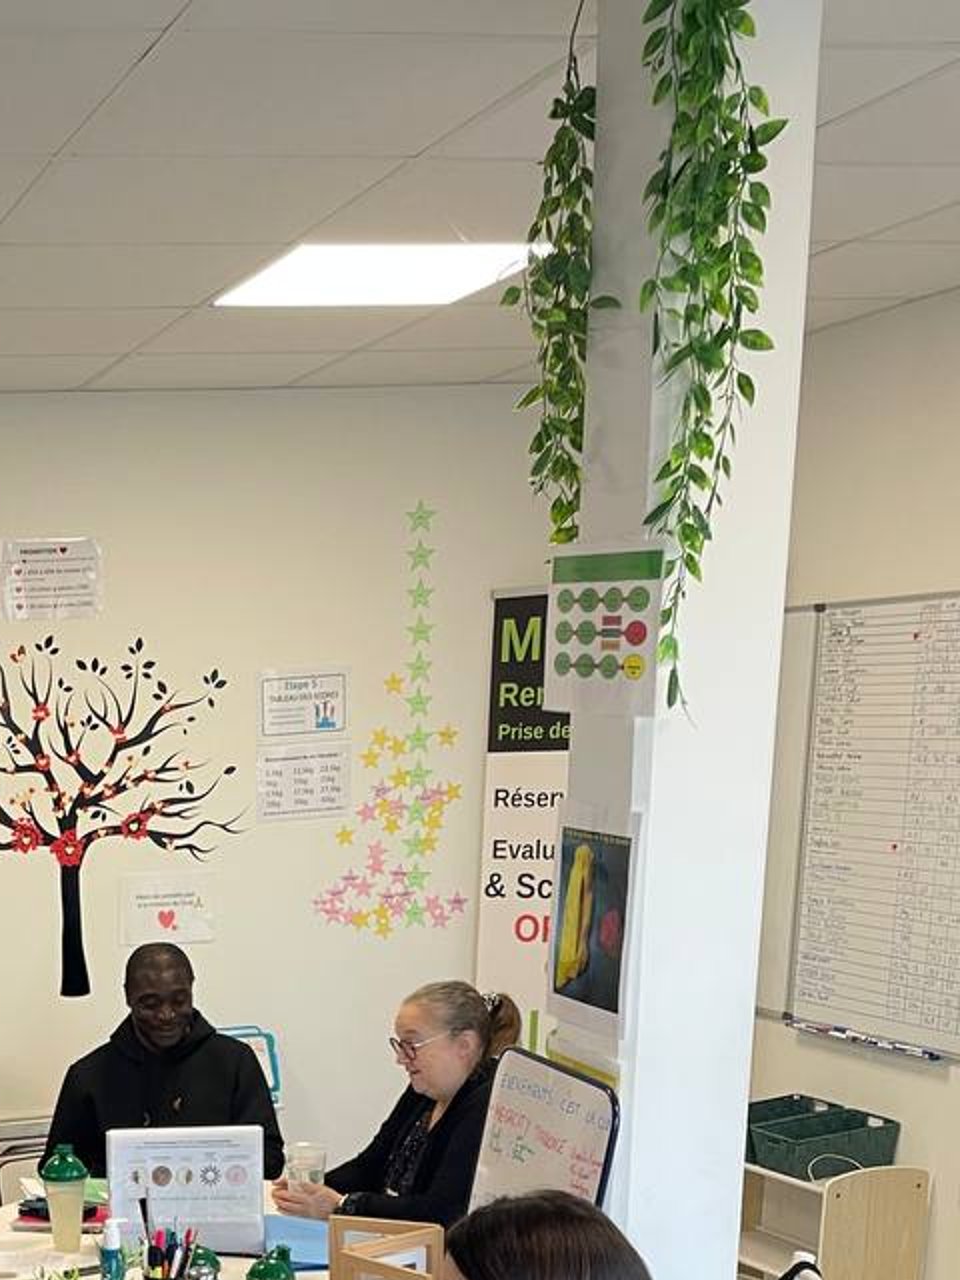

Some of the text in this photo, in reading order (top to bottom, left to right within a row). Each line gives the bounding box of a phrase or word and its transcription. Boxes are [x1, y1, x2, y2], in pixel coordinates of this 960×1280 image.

[498, 722, 571, 741] Prise de
[492, 840, 556, 861] Evalu
[484, 873, 553, 899] & Sc
